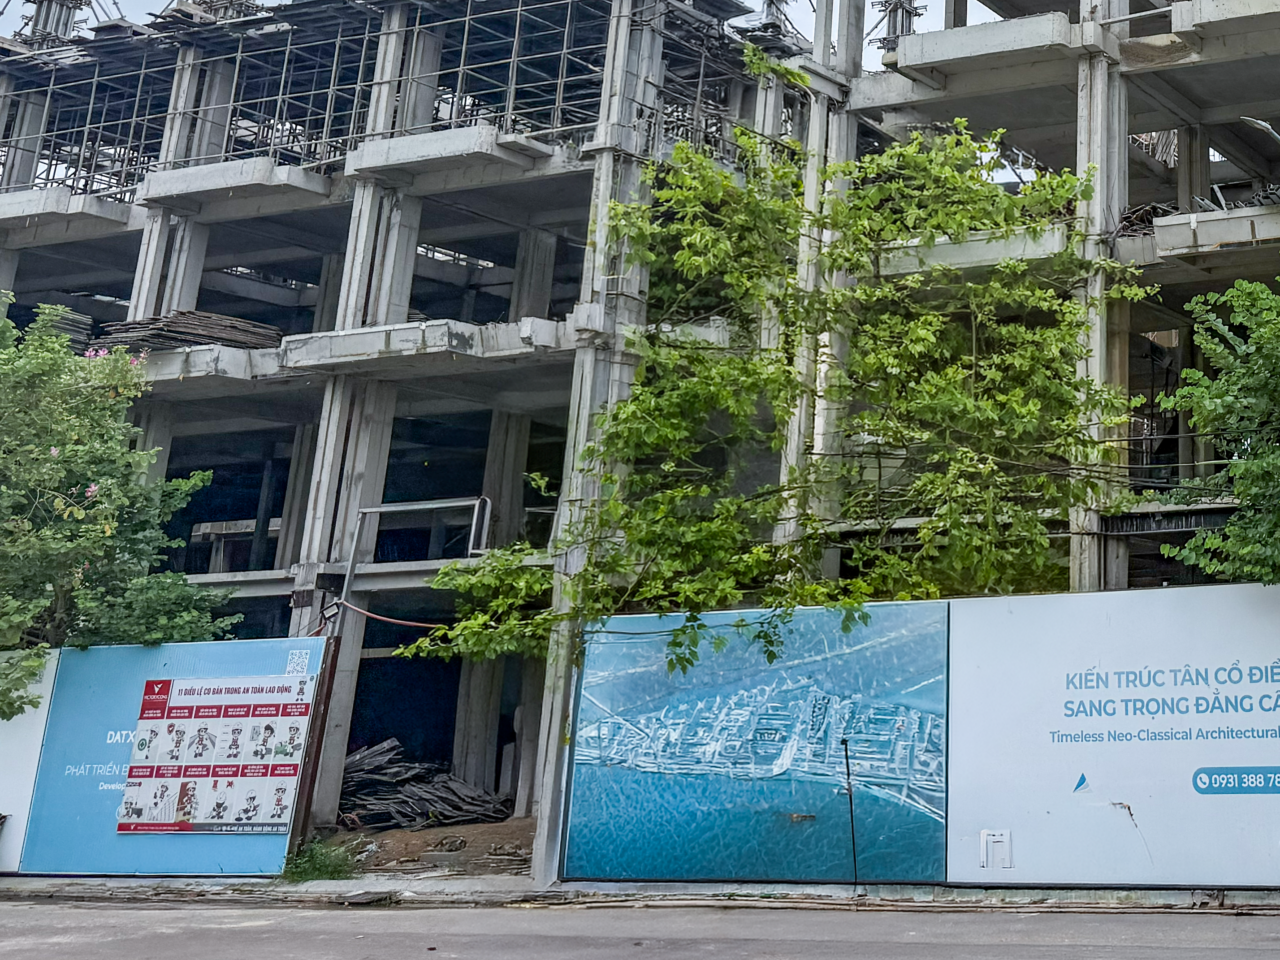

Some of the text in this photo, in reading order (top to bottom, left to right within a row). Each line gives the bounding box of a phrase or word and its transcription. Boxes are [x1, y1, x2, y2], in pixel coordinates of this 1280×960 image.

[1065, 665, 1109, 690] KIẾN
[1113, 665, 1166, 689] TRÚC
[1168, 664, 1209, 687] TÂN
[1214, 659, 1244, 685] CỔ
[1063, 699, 1117, 718] SANG
[1120, 696, 1190, 721] TRỌNG
[1193, 687, 1254, 714] ĐẲNG
[1049, 729, 1104, 743] Timeless
[1107, 727, 1192, 742] Neo-Classical
[64, 762, 91, 776] PHÁT
[1211, 774, 1239, 788] 0931
[1241, 773, 1265, 788] 388
